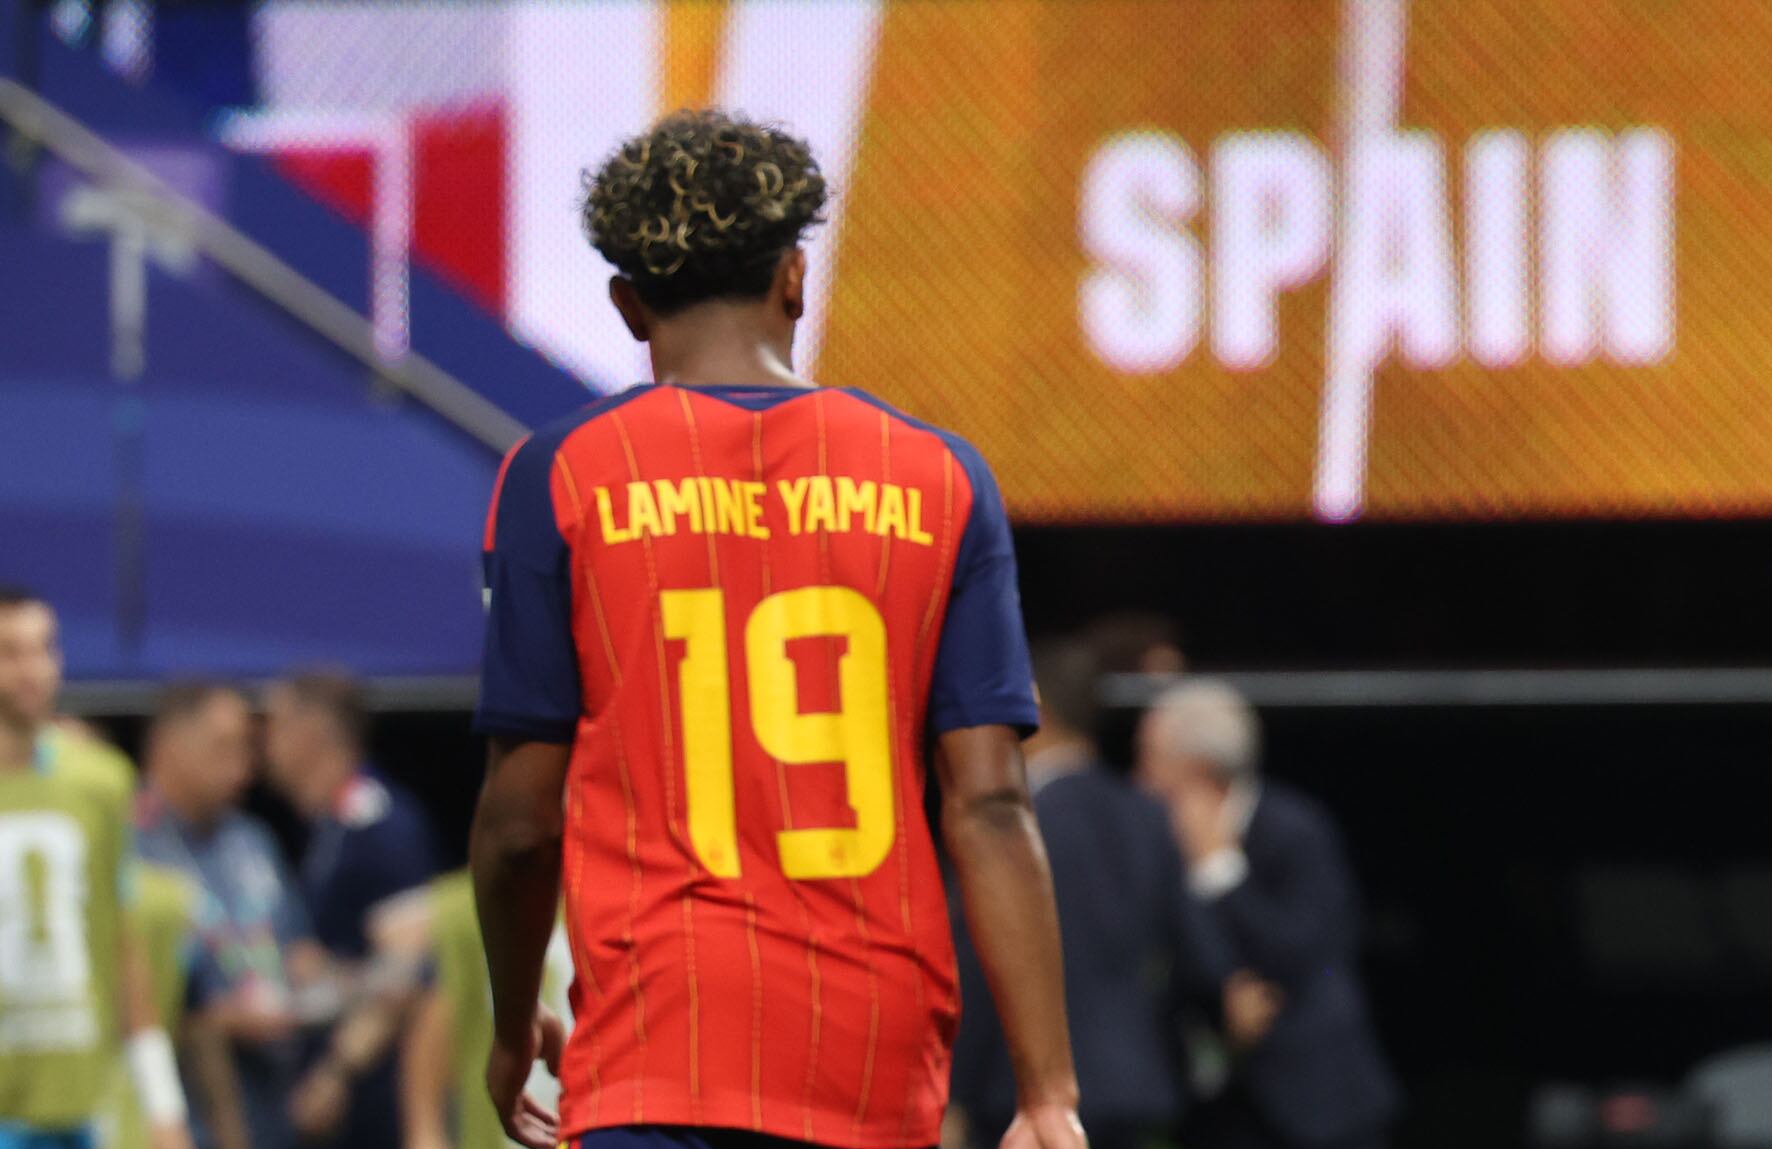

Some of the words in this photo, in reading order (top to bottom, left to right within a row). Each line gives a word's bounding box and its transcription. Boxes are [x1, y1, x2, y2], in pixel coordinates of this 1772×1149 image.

[1077, 126, 1677, 373] SPAIN
[594, 477, 770, 545] LAMINE
[777, 475, 934, 546] YAMAL
[660, 585, 897, 880] 19
